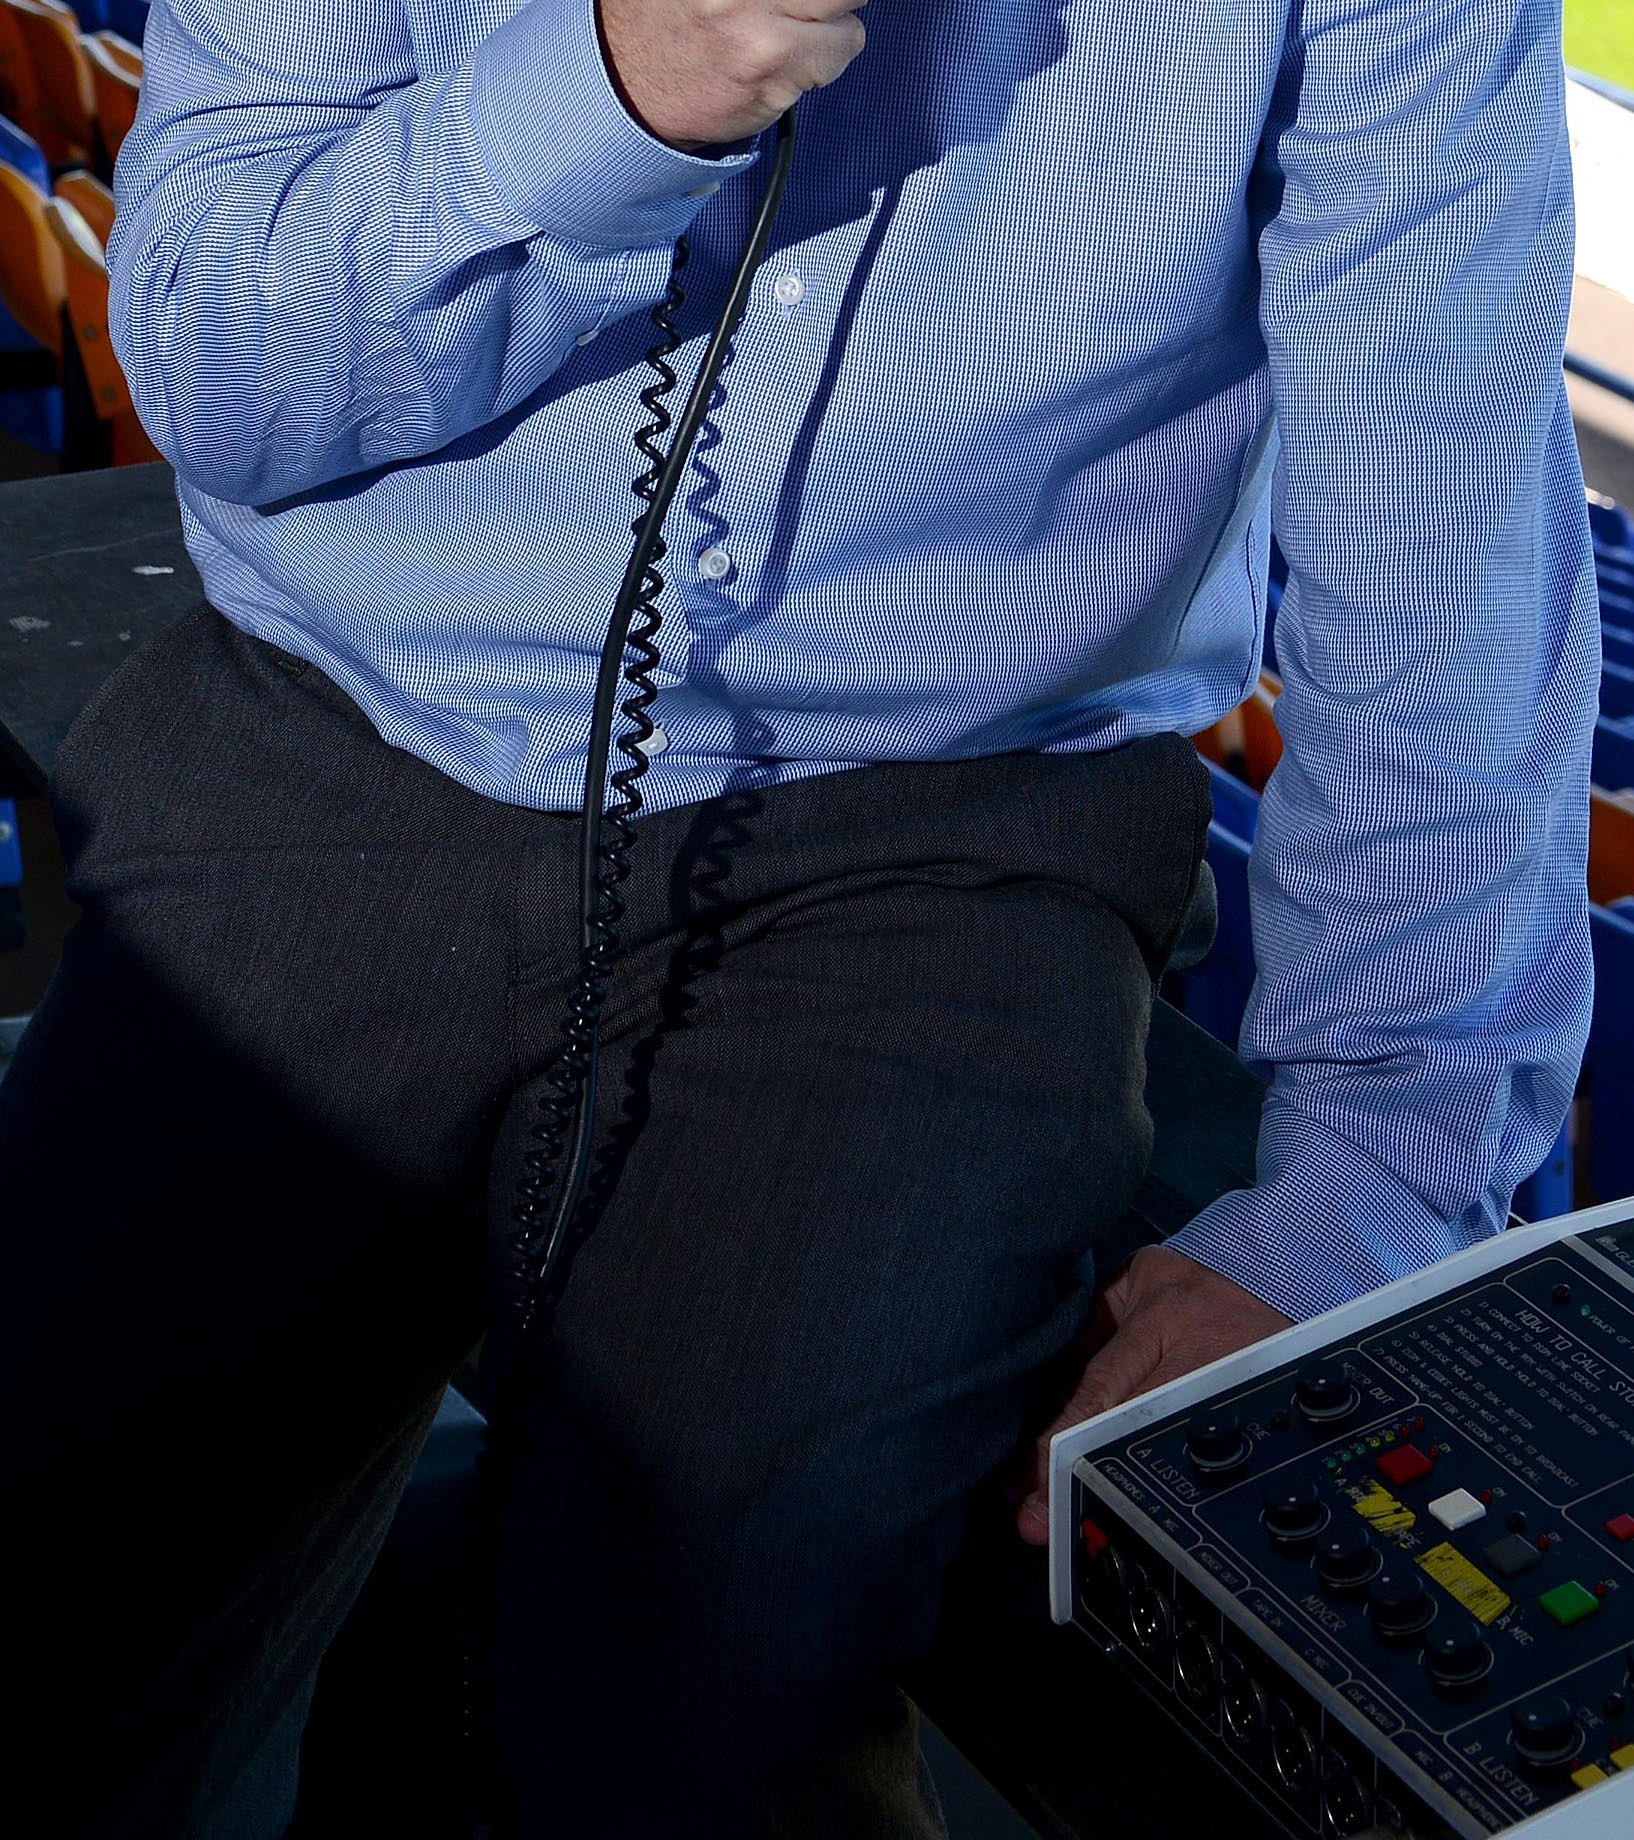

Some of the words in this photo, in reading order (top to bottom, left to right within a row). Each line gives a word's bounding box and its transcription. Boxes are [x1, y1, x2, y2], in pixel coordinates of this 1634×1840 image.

[1512, 1309, 1552, 1334] HOW
[1544, 1333, 1573, 1351] TO
[1567, 1351, 1611, 1379] CALL
[1150, 1458, 1203, 1500] LISTEN
[1301, 1594, 1347, 1632] MIXER
[1463, 1739, 1483, 1756] B
[1479, 1753, 1541, 1806] LISTEN
